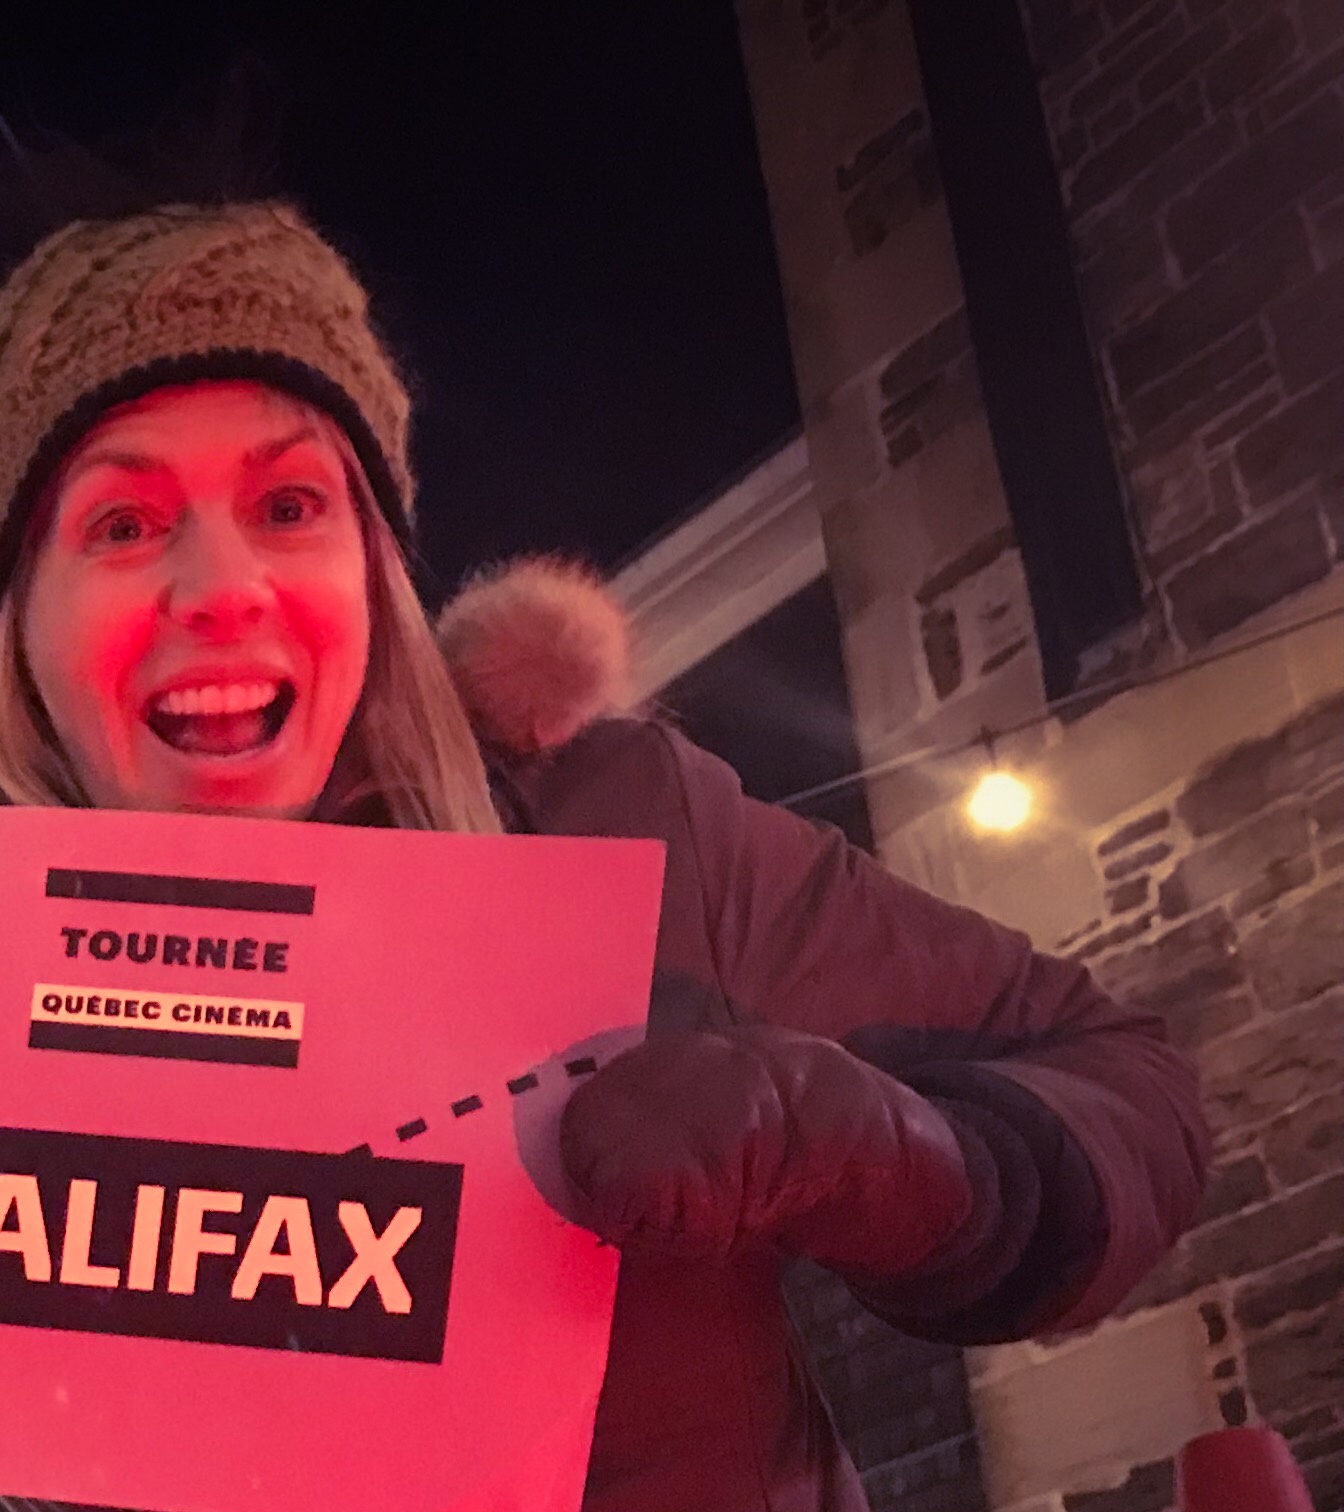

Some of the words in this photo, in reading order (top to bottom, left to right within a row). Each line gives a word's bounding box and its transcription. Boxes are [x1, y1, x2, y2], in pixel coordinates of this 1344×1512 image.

[60, 927, 289, 973] TOURNÉE
[42, 993, 161, 1021] QUÉBEC
[172, 1003, 292, 1030] CINÉMA
